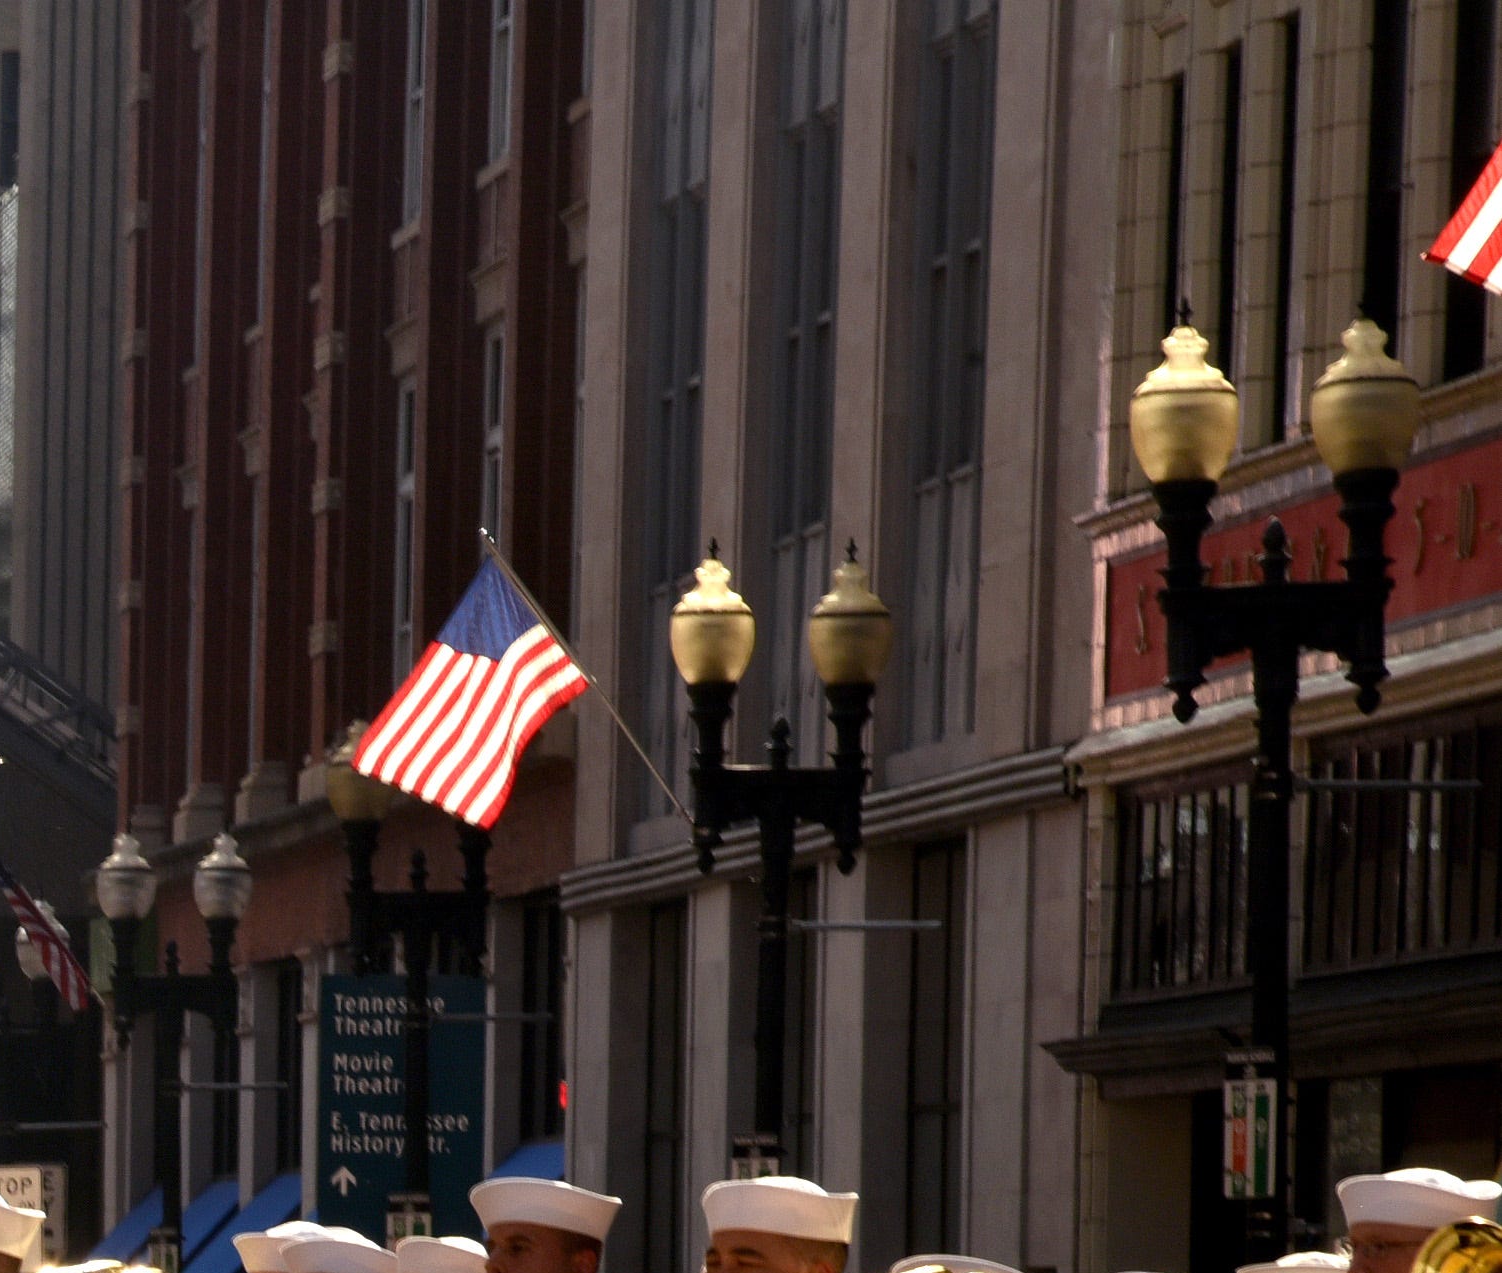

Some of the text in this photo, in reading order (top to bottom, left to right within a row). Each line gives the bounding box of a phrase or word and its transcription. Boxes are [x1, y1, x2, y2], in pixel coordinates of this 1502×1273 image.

[333, 992, 446, 1015] Tennese
[333, 1015, 402, 1036] Theatr
[332, 1050, 394, 1073] Movie
[332, 1073, 406, 1096] Theatr
[330, 1133, 406, 1158] History
